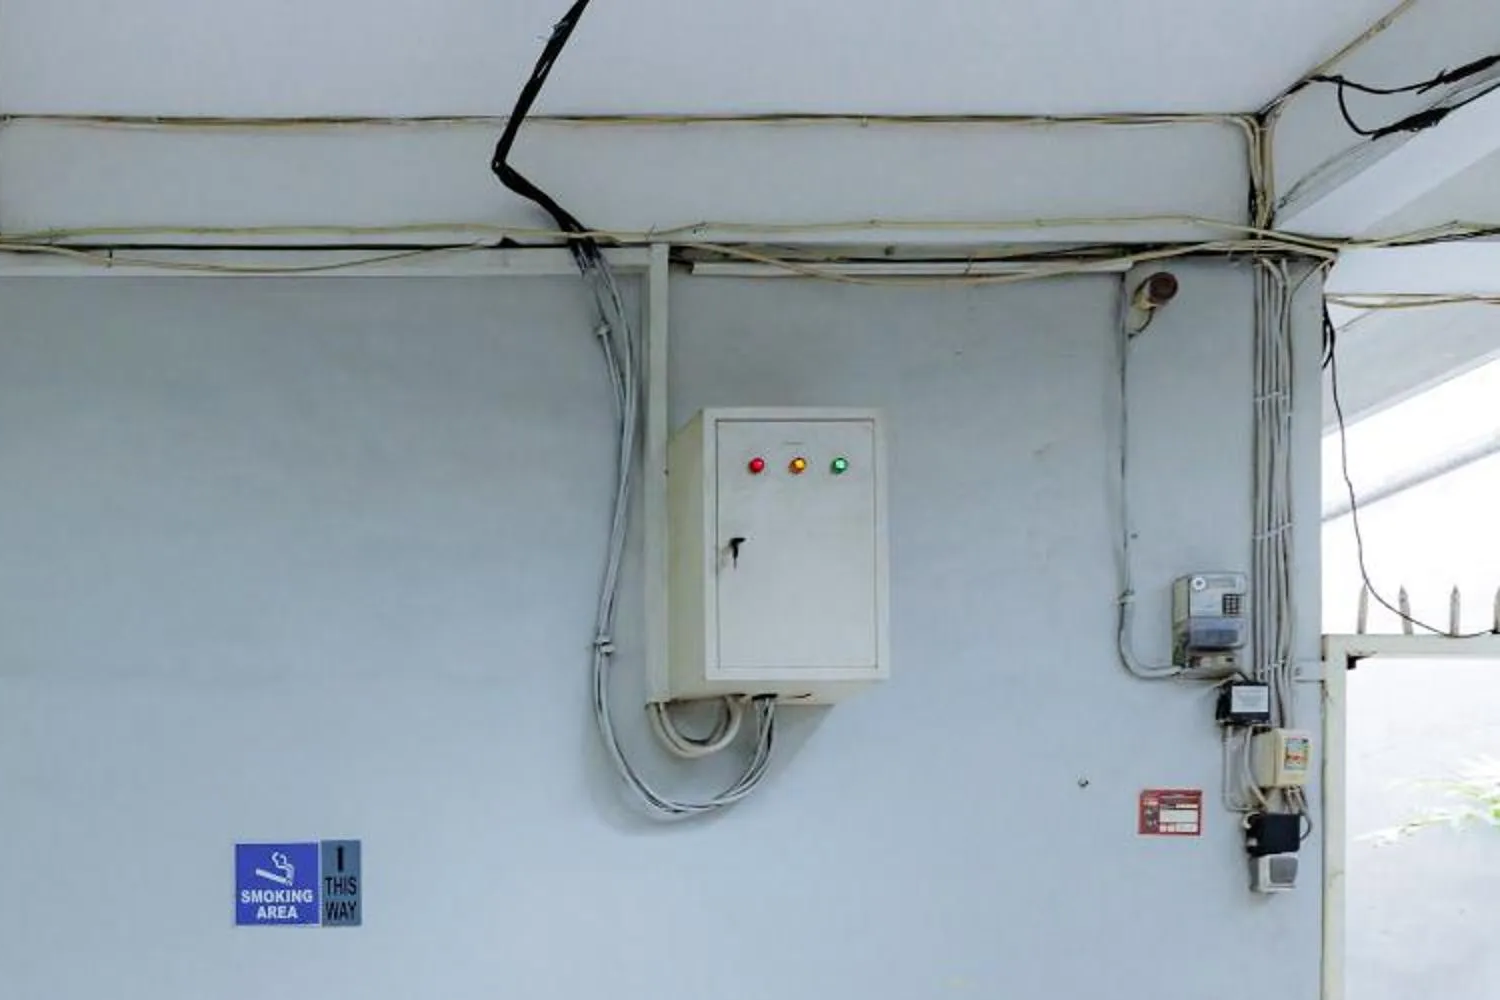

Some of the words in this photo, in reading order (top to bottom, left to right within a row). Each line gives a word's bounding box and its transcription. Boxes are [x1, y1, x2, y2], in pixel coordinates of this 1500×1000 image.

[325, 876, 357, 896] THIS
[241, 889, 314, 903] SMOKING
[256, 905, 298, 919] AREA
[325, 901, 357, 921] WAY
